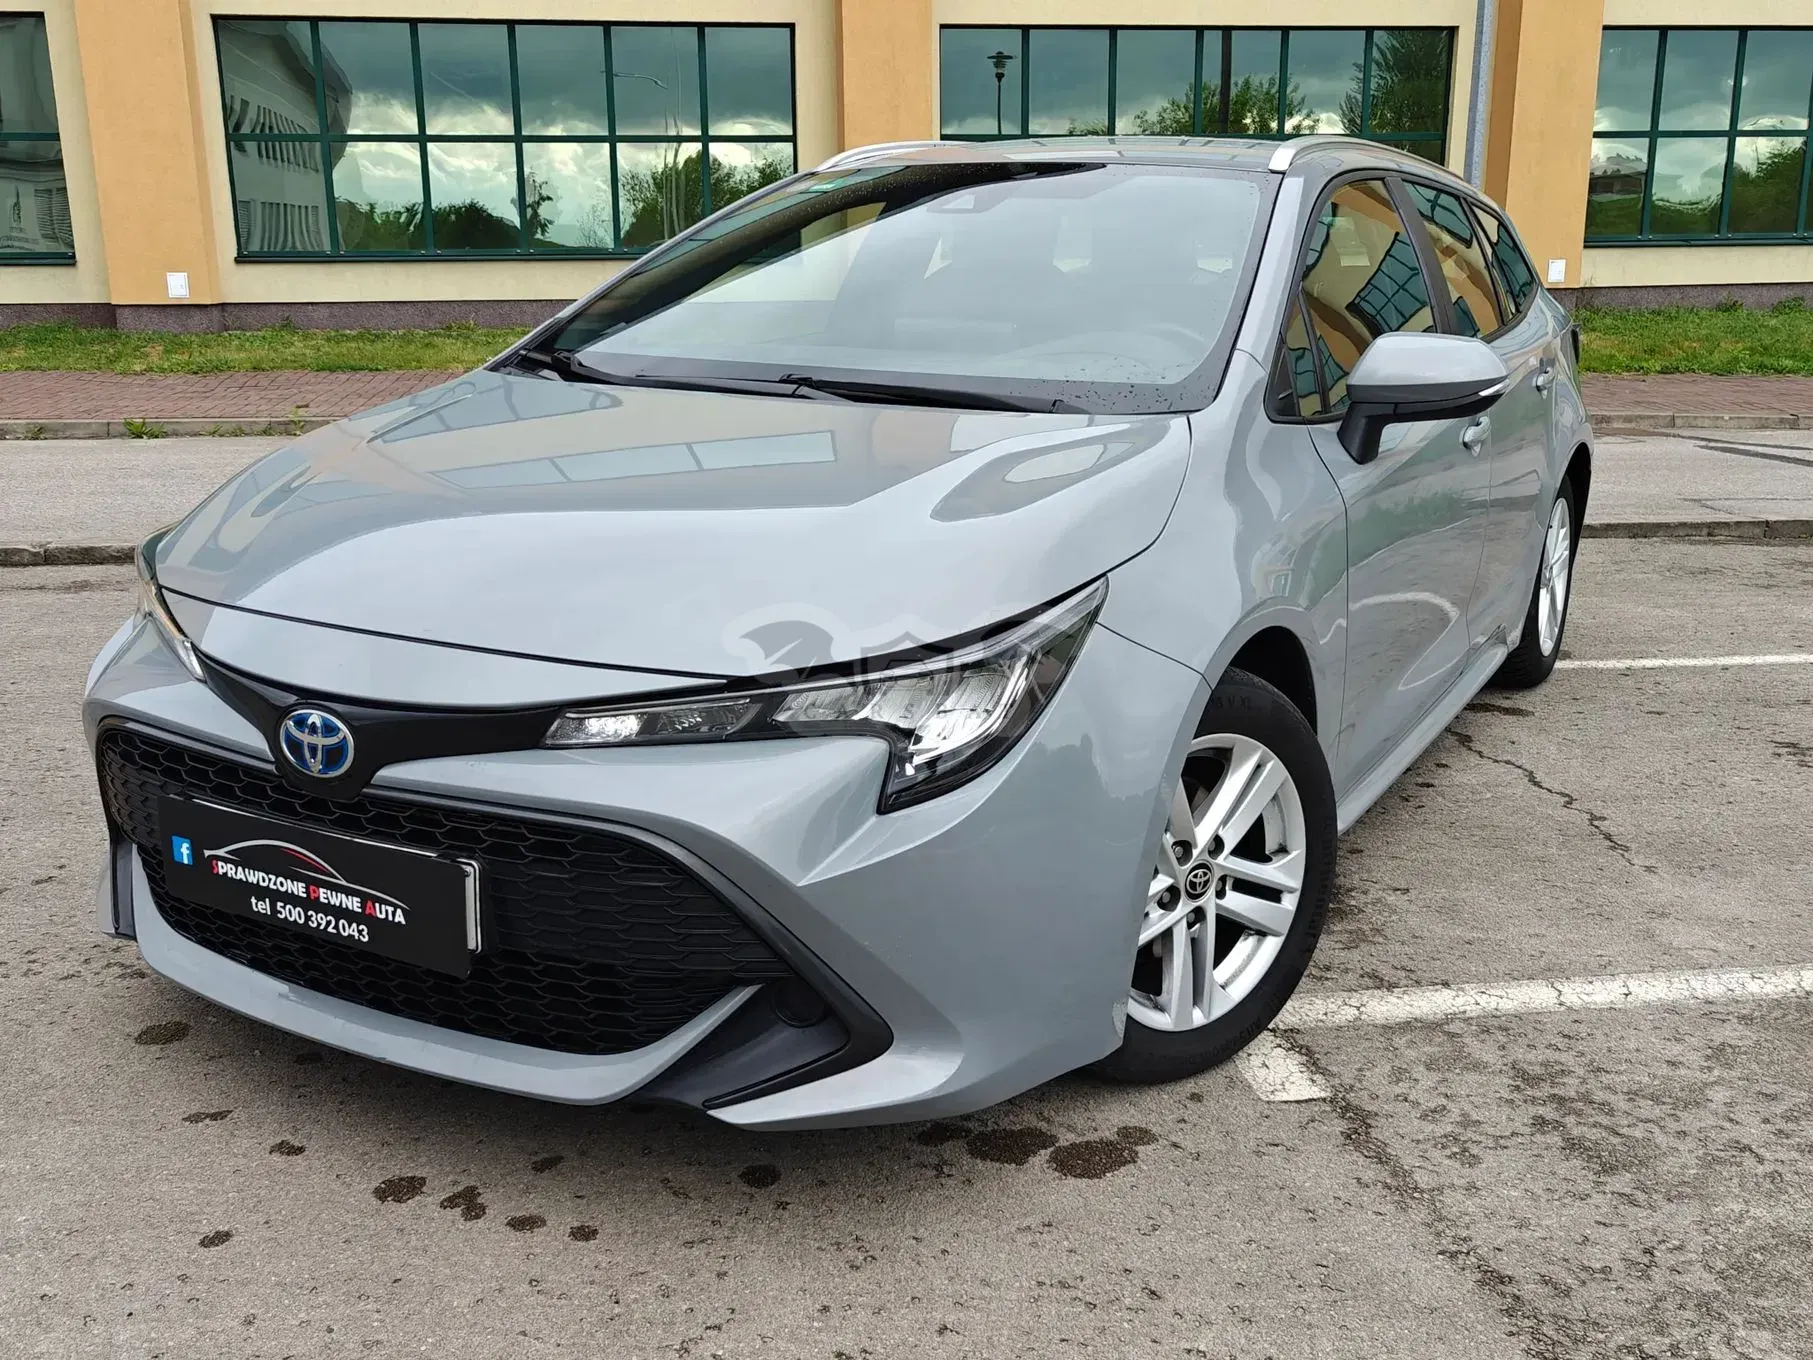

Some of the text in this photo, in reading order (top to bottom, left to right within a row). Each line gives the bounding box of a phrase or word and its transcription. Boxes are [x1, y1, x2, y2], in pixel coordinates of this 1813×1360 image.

[211, 859, 407, 925] SPRAWDZONE PEWNE AUTA
[250, 895, 369, 943] tel 500 392 043
